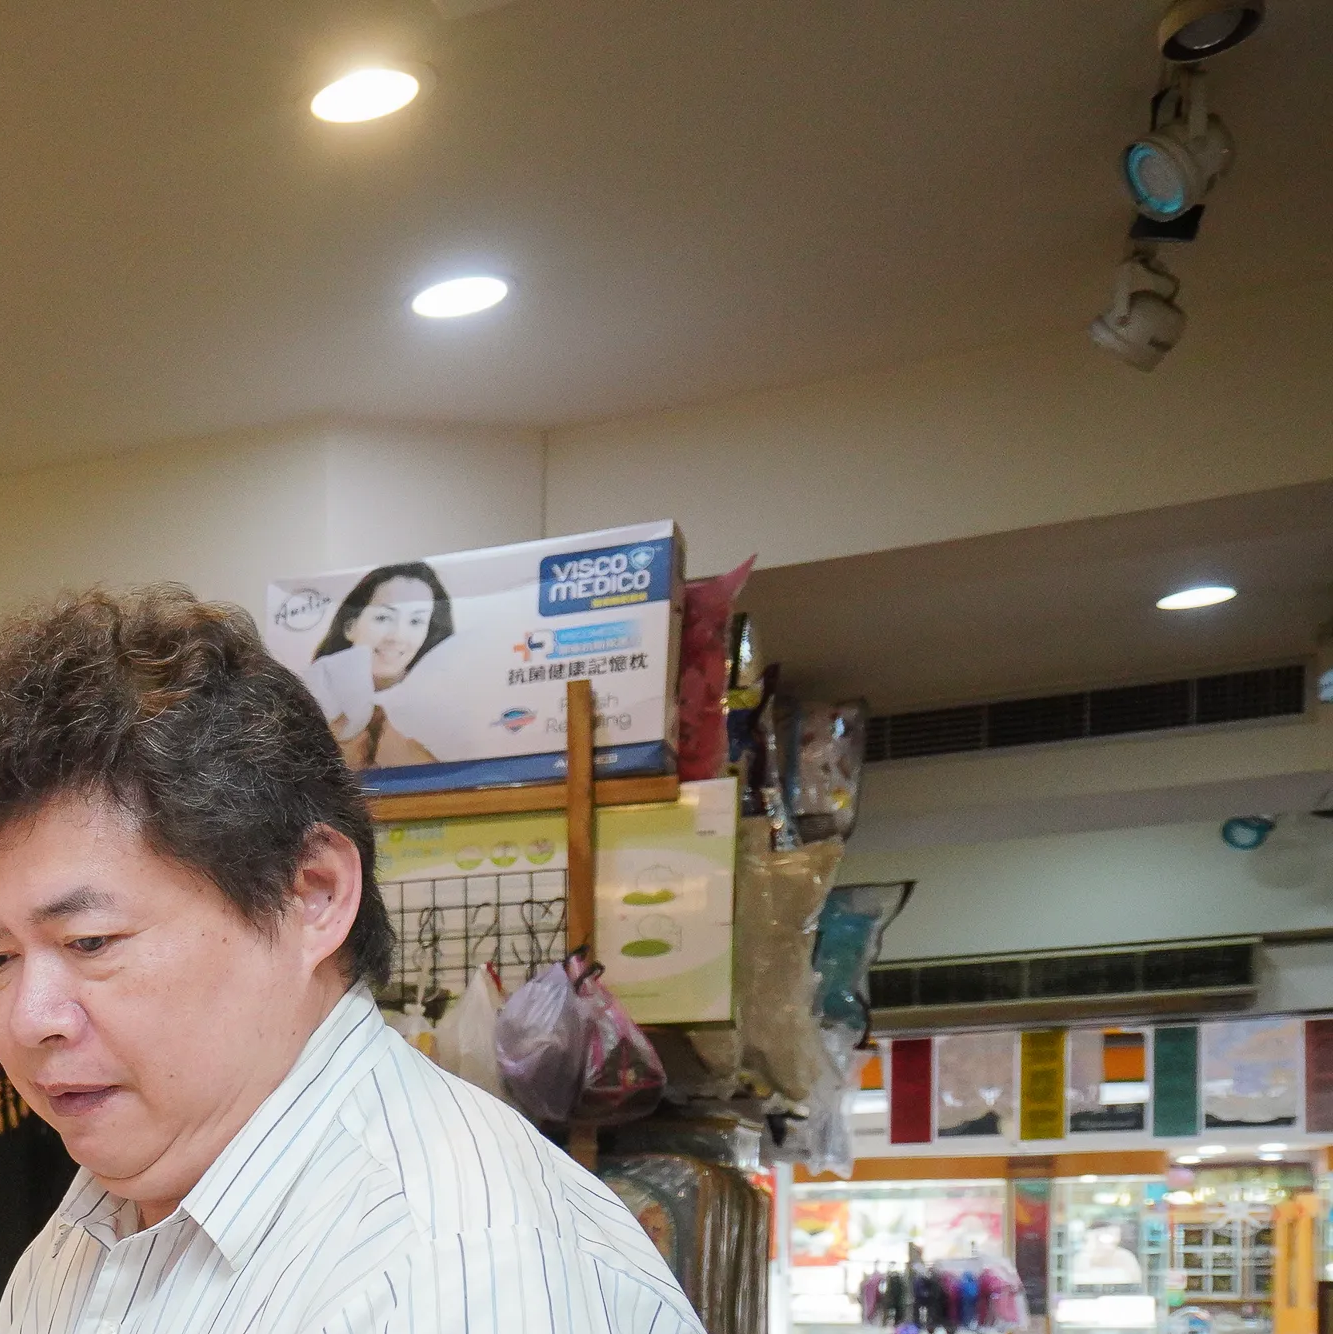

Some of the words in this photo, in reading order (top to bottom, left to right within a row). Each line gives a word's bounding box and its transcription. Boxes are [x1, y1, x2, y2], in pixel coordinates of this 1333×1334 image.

[552, 553, 628, 582] VISCO
[549, 570, 651, 603] MEDICO
[507, 651, 649, 687] 抗菌健康記憶枕
